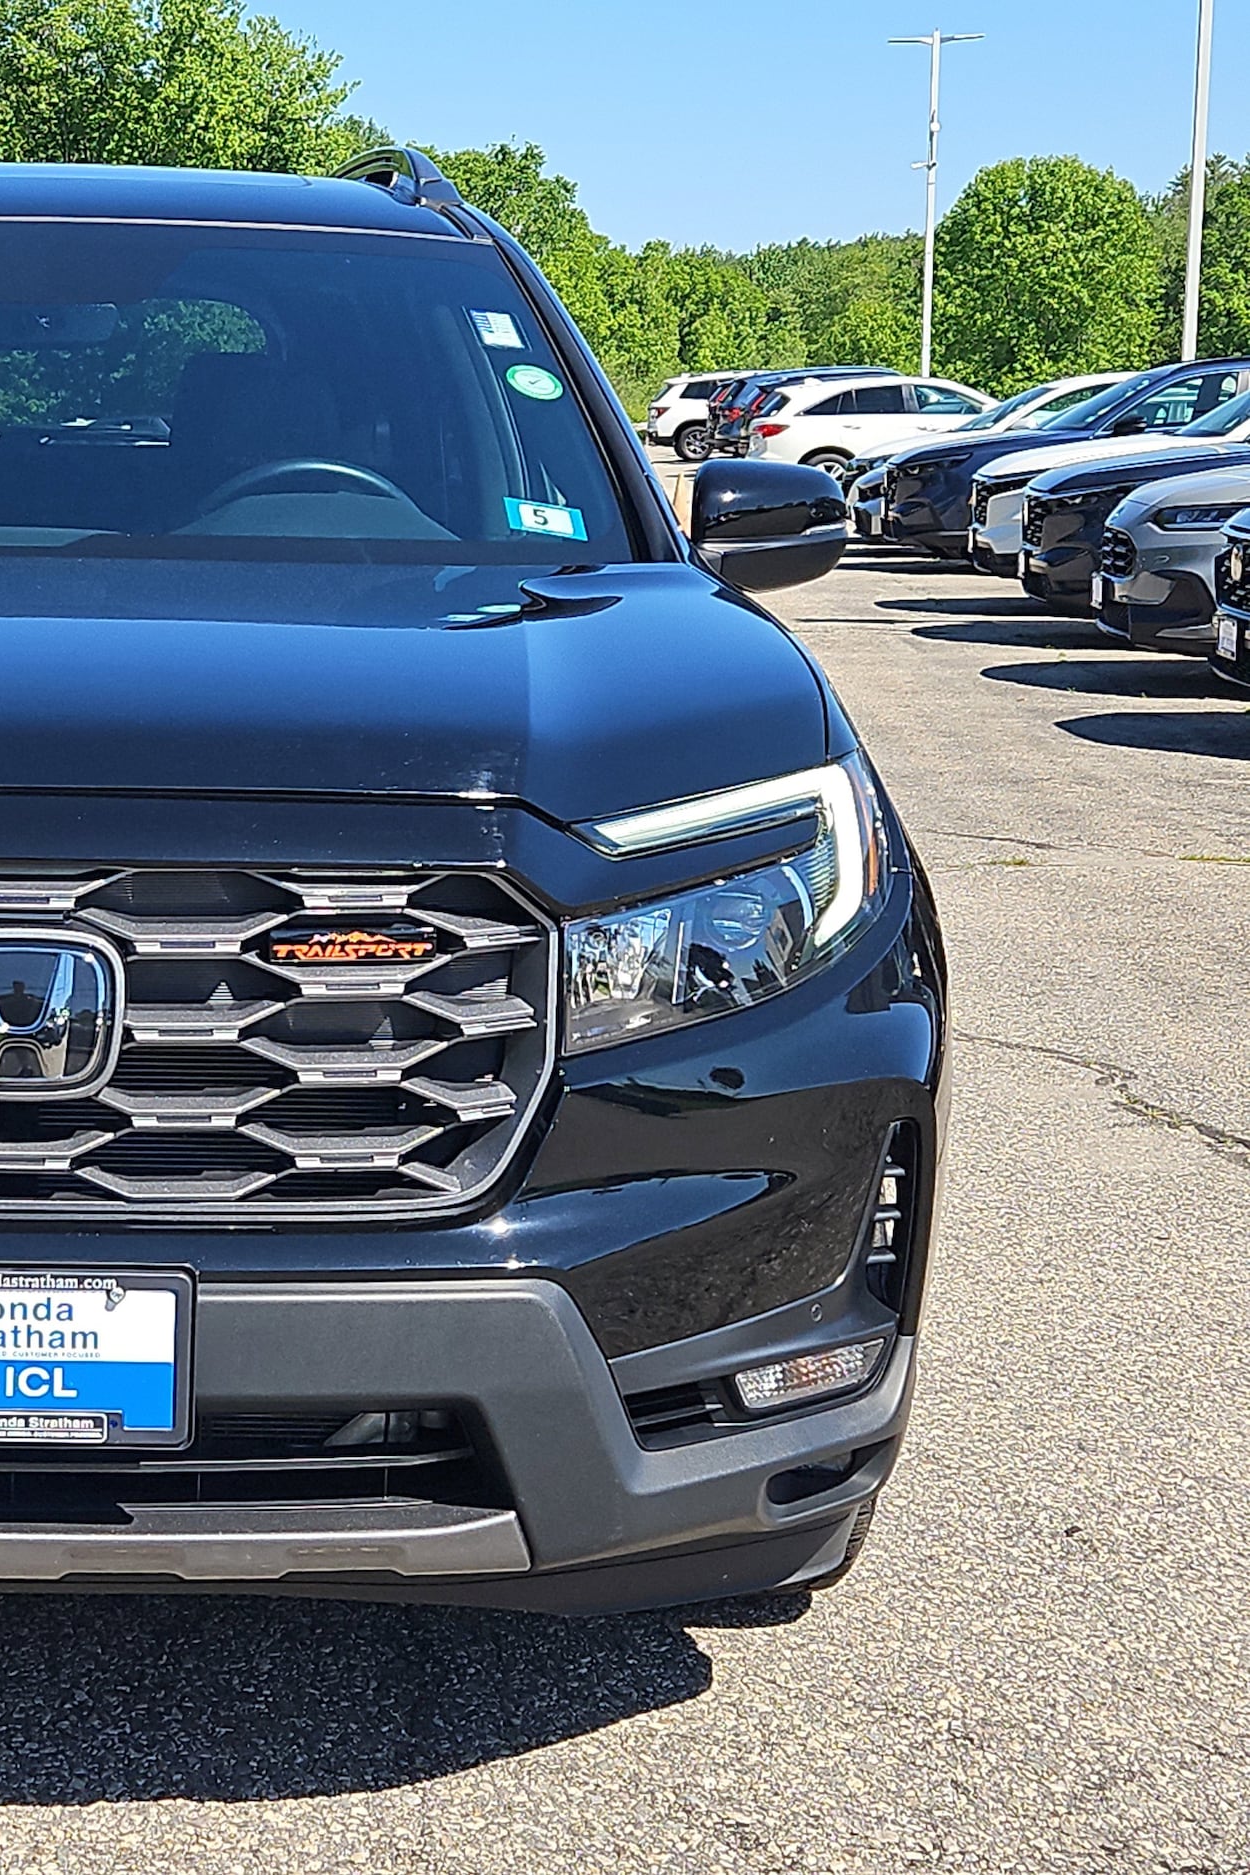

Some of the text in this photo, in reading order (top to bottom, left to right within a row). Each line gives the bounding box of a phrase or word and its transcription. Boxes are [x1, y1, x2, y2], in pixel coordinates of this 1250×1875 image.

[532, 508, 549, 526] 5
[272, 943, 433, 960] TRAILSPORT
[4, 1365, 78, 1399] ICL
[27, 1416, 95, 1430] Stratham
